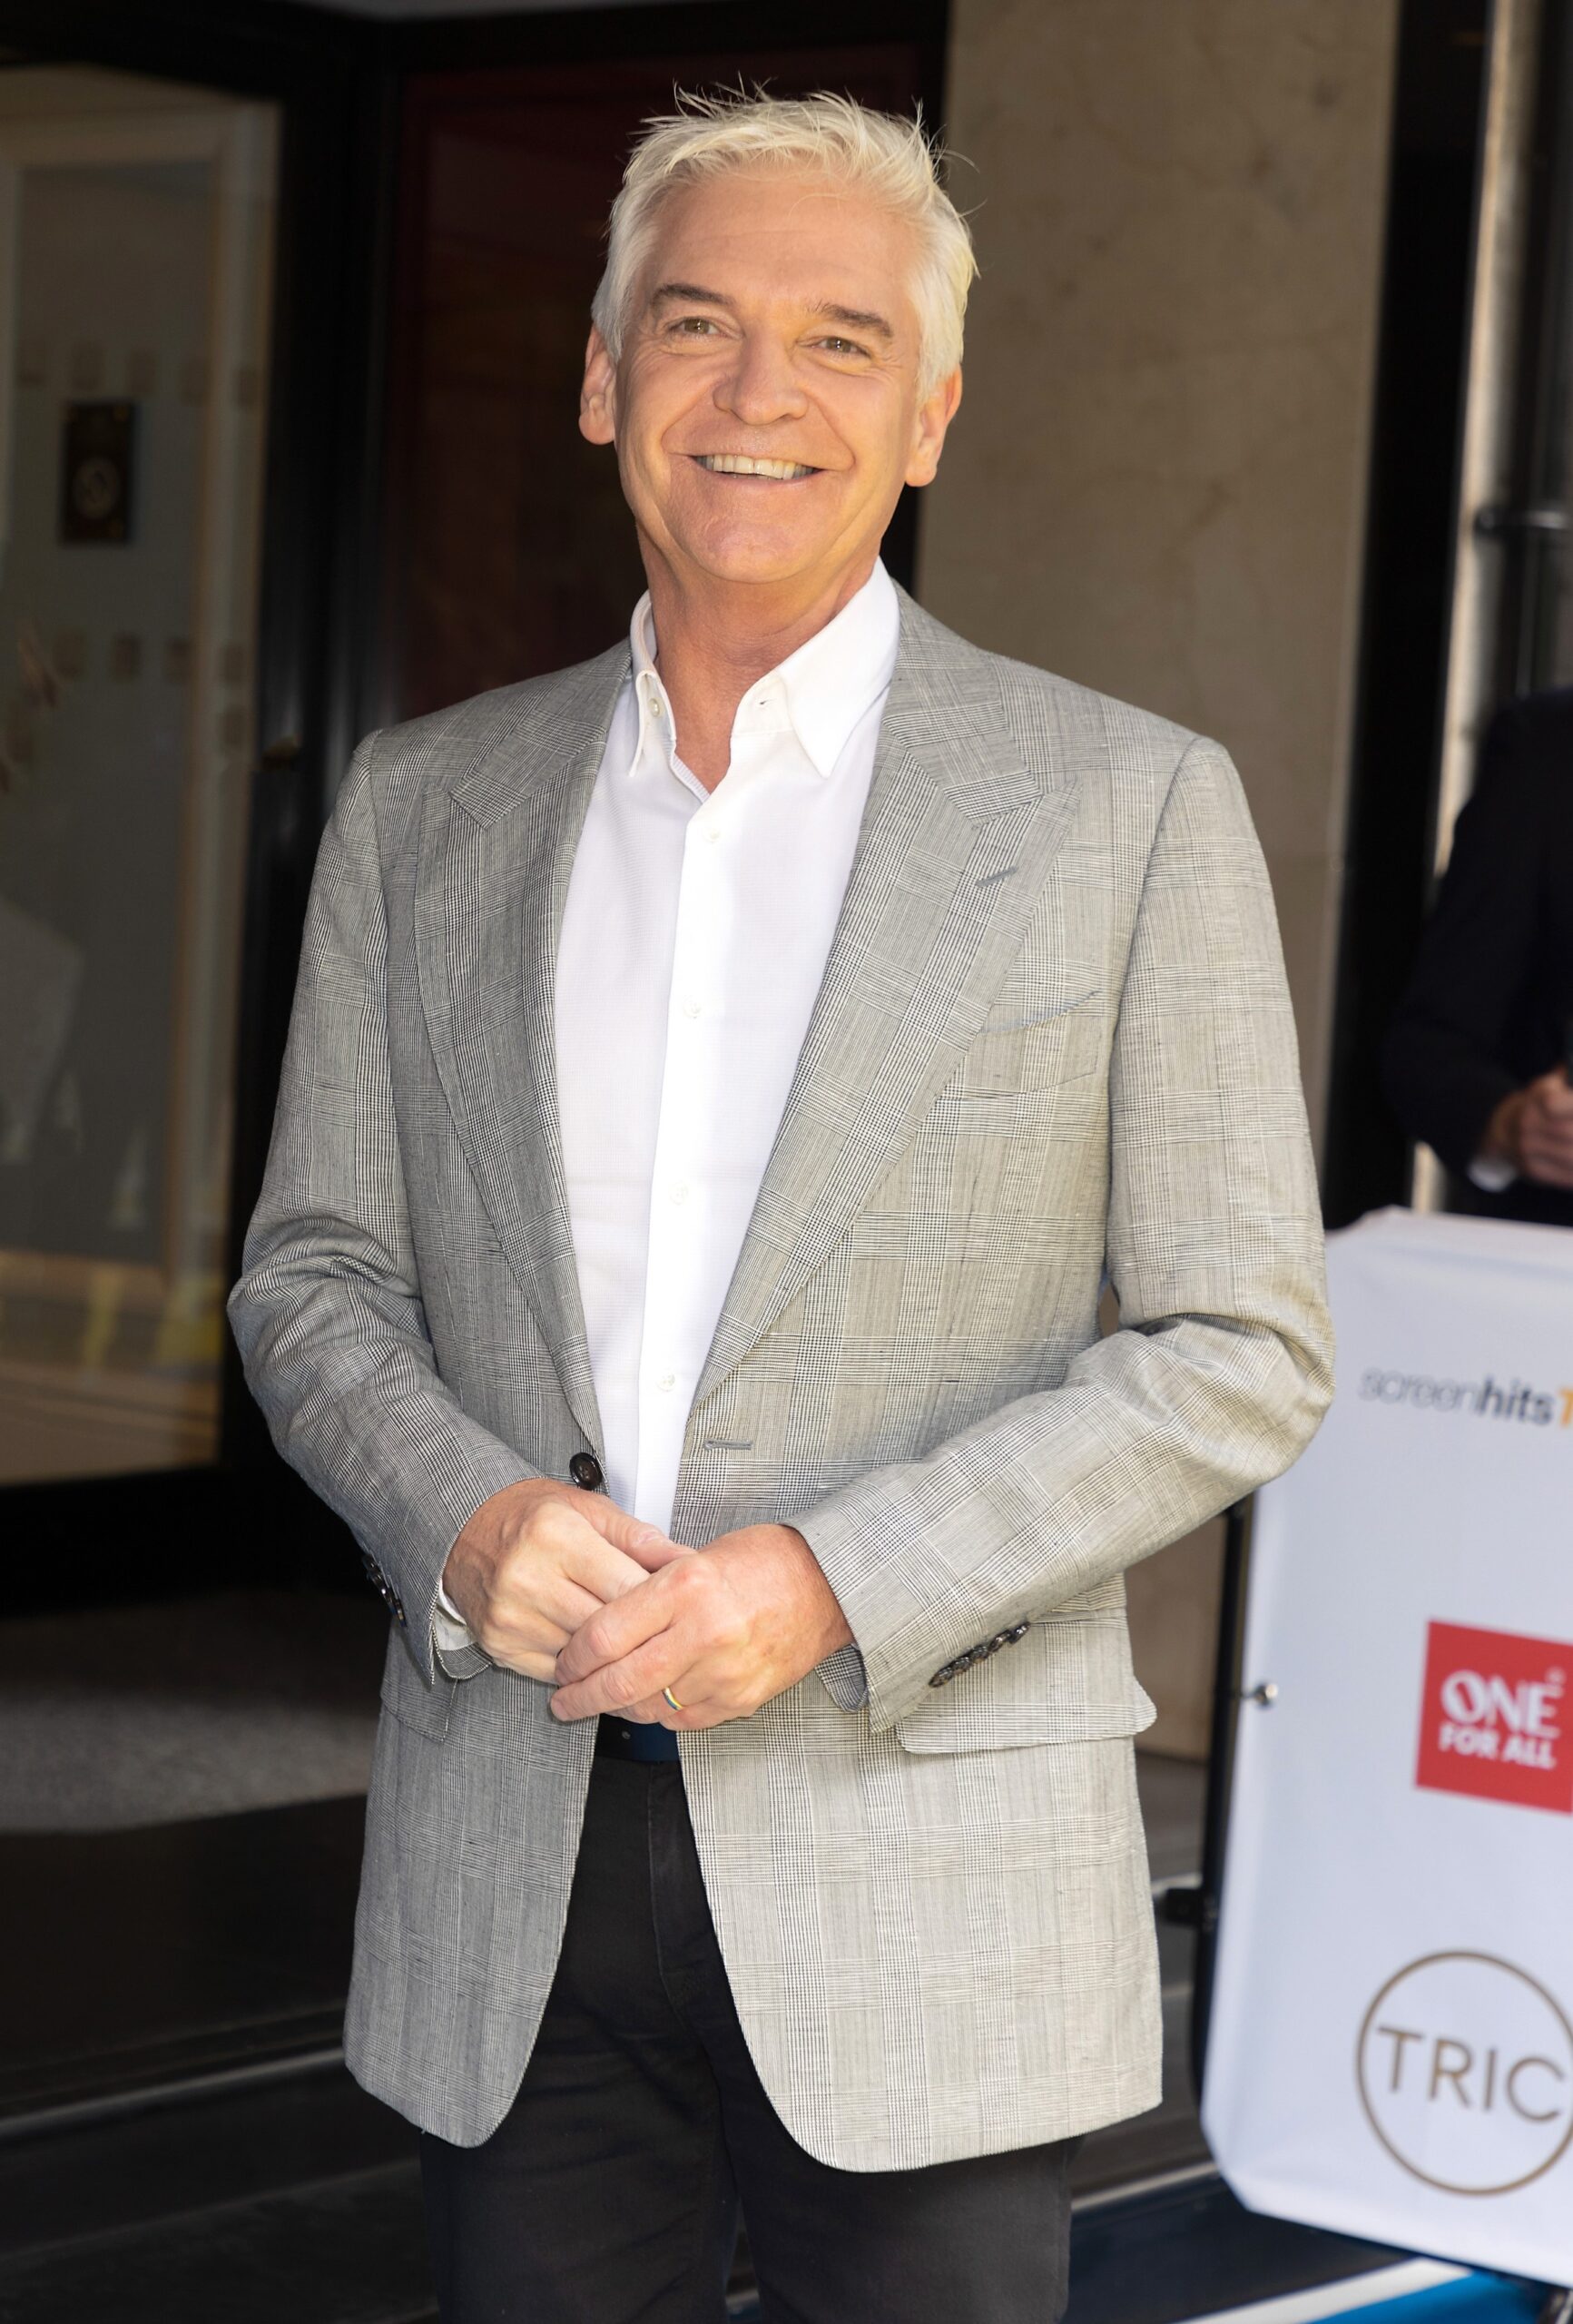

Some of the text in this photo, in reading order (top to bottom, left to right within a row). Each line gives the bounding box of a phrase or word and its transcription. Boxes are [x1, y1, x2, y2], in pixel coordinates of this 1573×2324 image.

[1440, 1669, 1564, 1740] ONE
[1438, 1719, 1558, 1771] FOR ALL
[1376, 2024, 1565, 2124] TRIC
